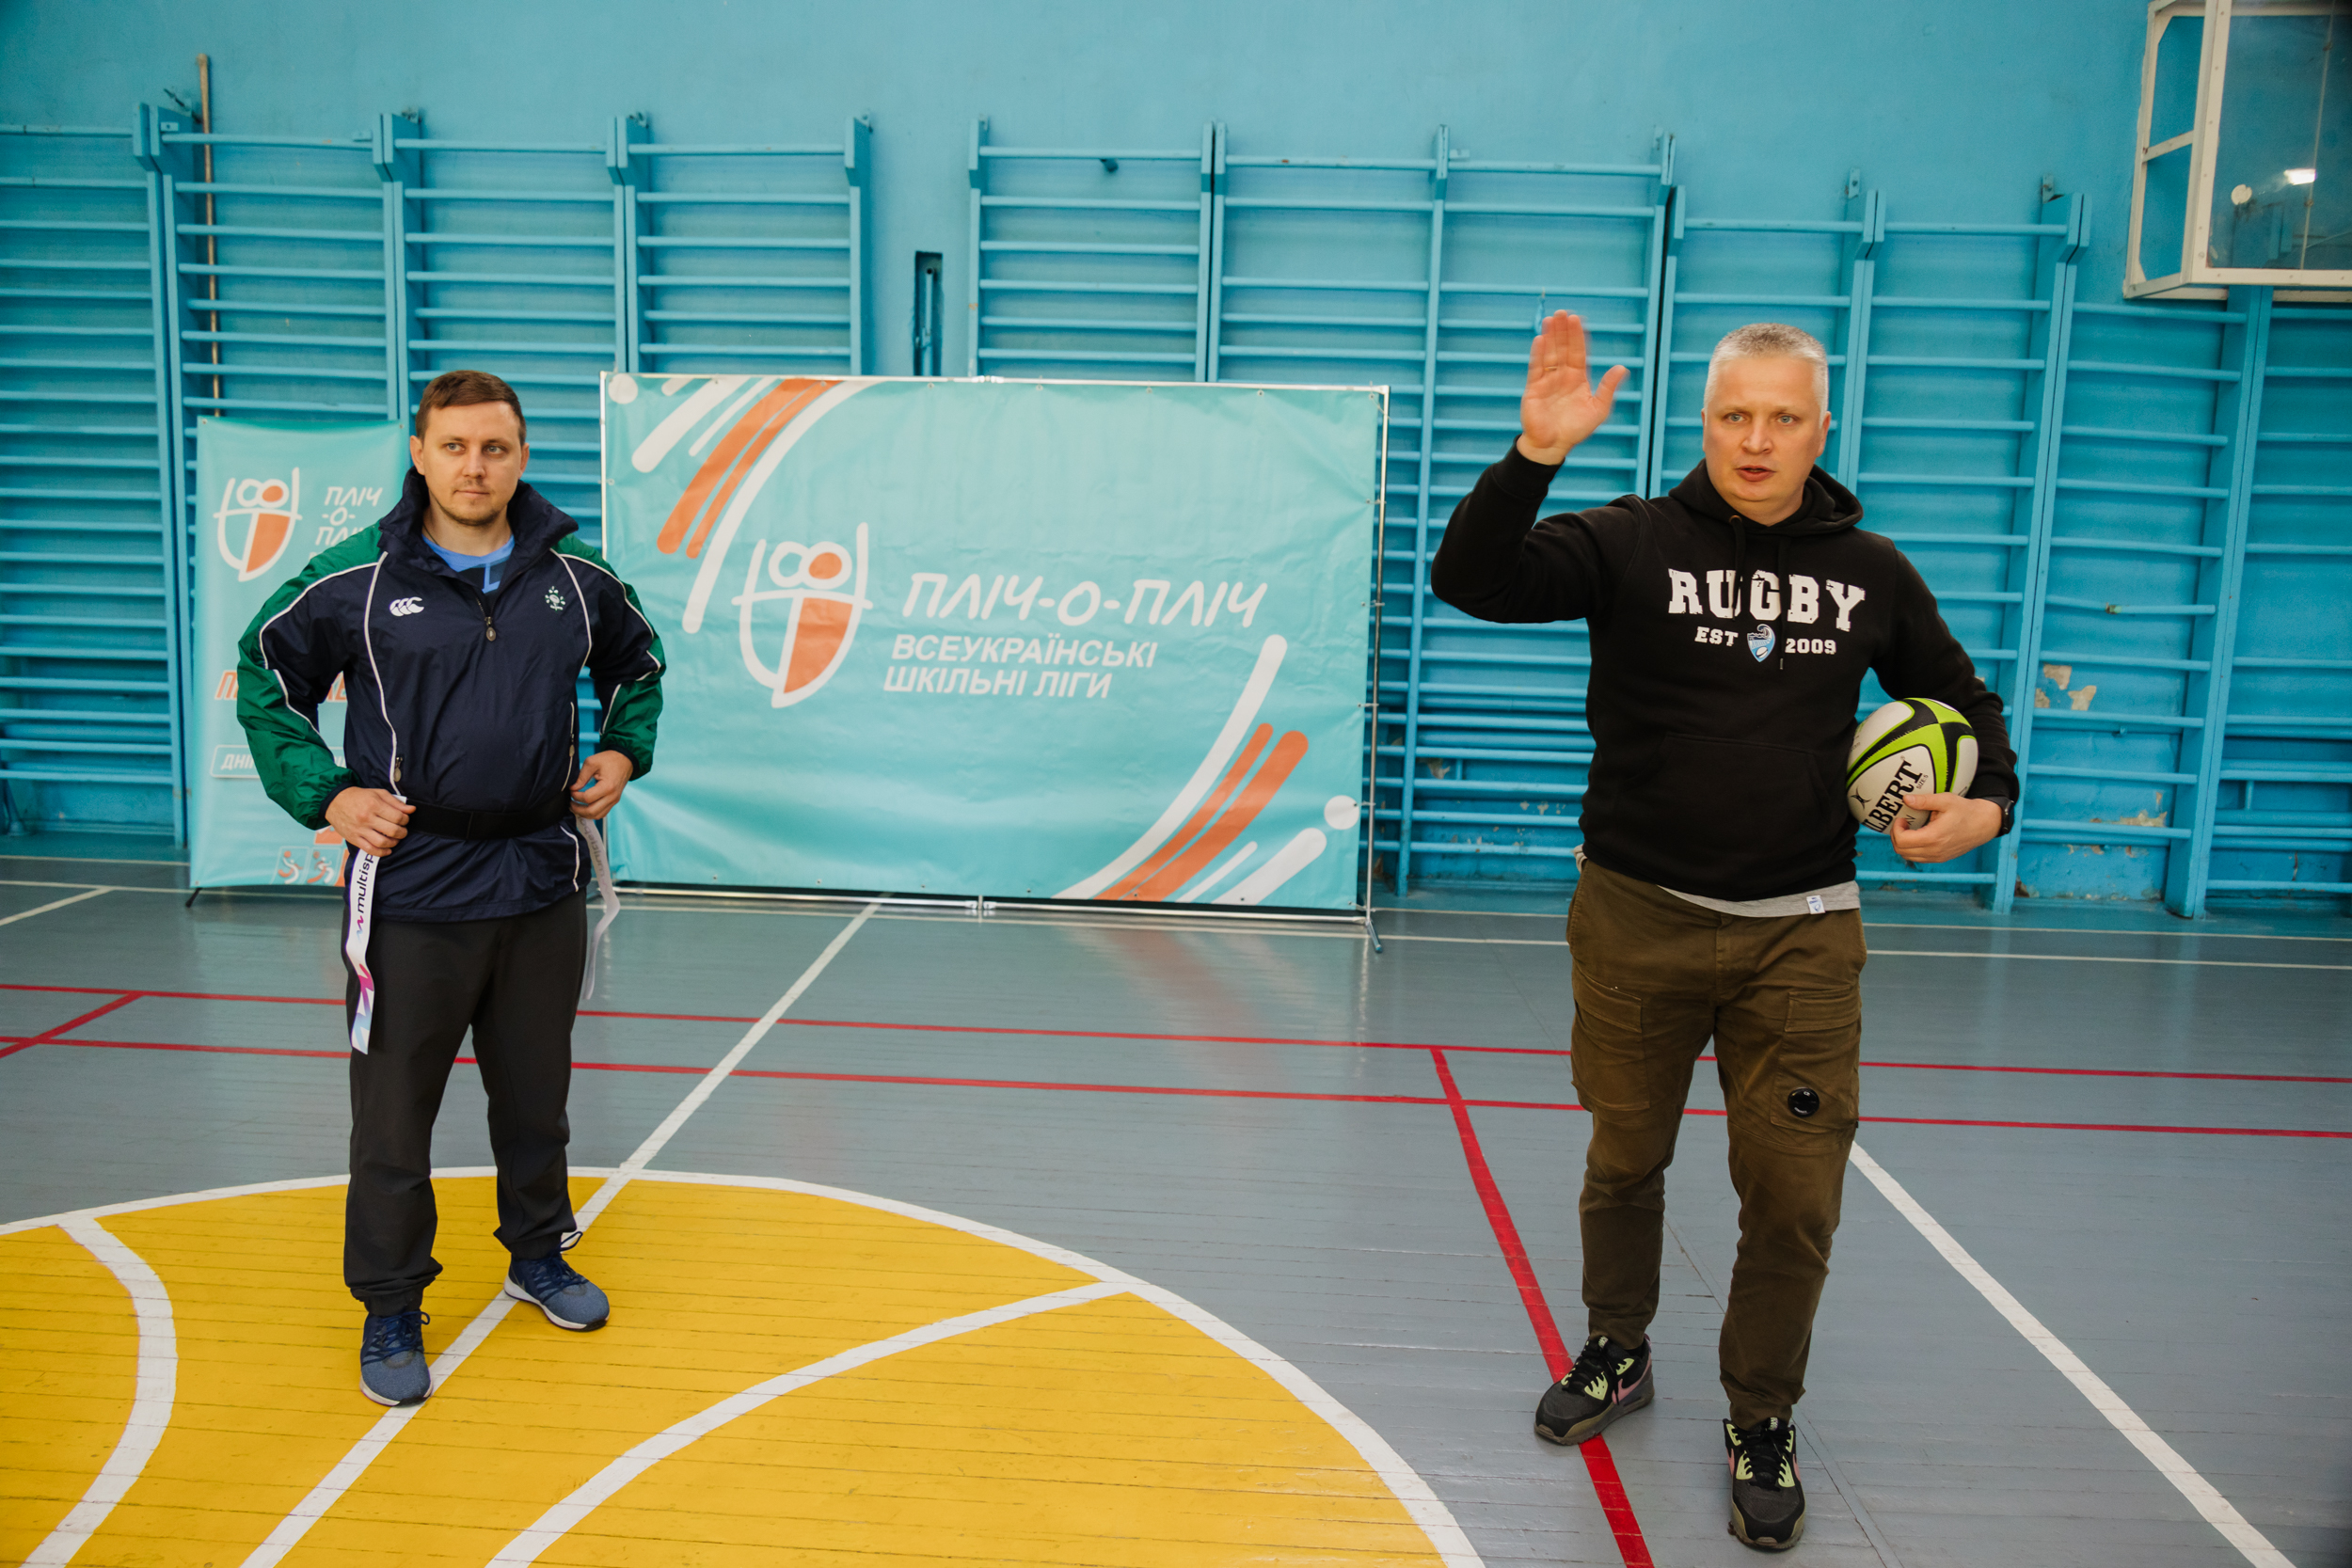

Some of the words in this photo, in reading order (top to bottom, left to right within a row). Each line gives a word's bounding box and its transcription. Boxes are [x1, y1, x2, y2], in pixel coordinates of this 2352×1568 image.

[324, 486, 383, 506] ПЛІЧ
[315, 527, 364, 546] ПЛ
[902, 572, 1268, 628] ПЛІЧ-О-ПЛІЧ
[1668, 568, 1866, 632] RUGBY
[891, 632, 1158, 669] ВСЕУКРАЇНСЬКІ
[1694, 626, 1739, 646] EST
[1785, 638, 1836, 655] 2009
[882, 666, 1028, 696] ШКІЛЬНІ
[1033, 671, 1113, 699] ЛІГИ
[357, 852, 373, 914] multisp
